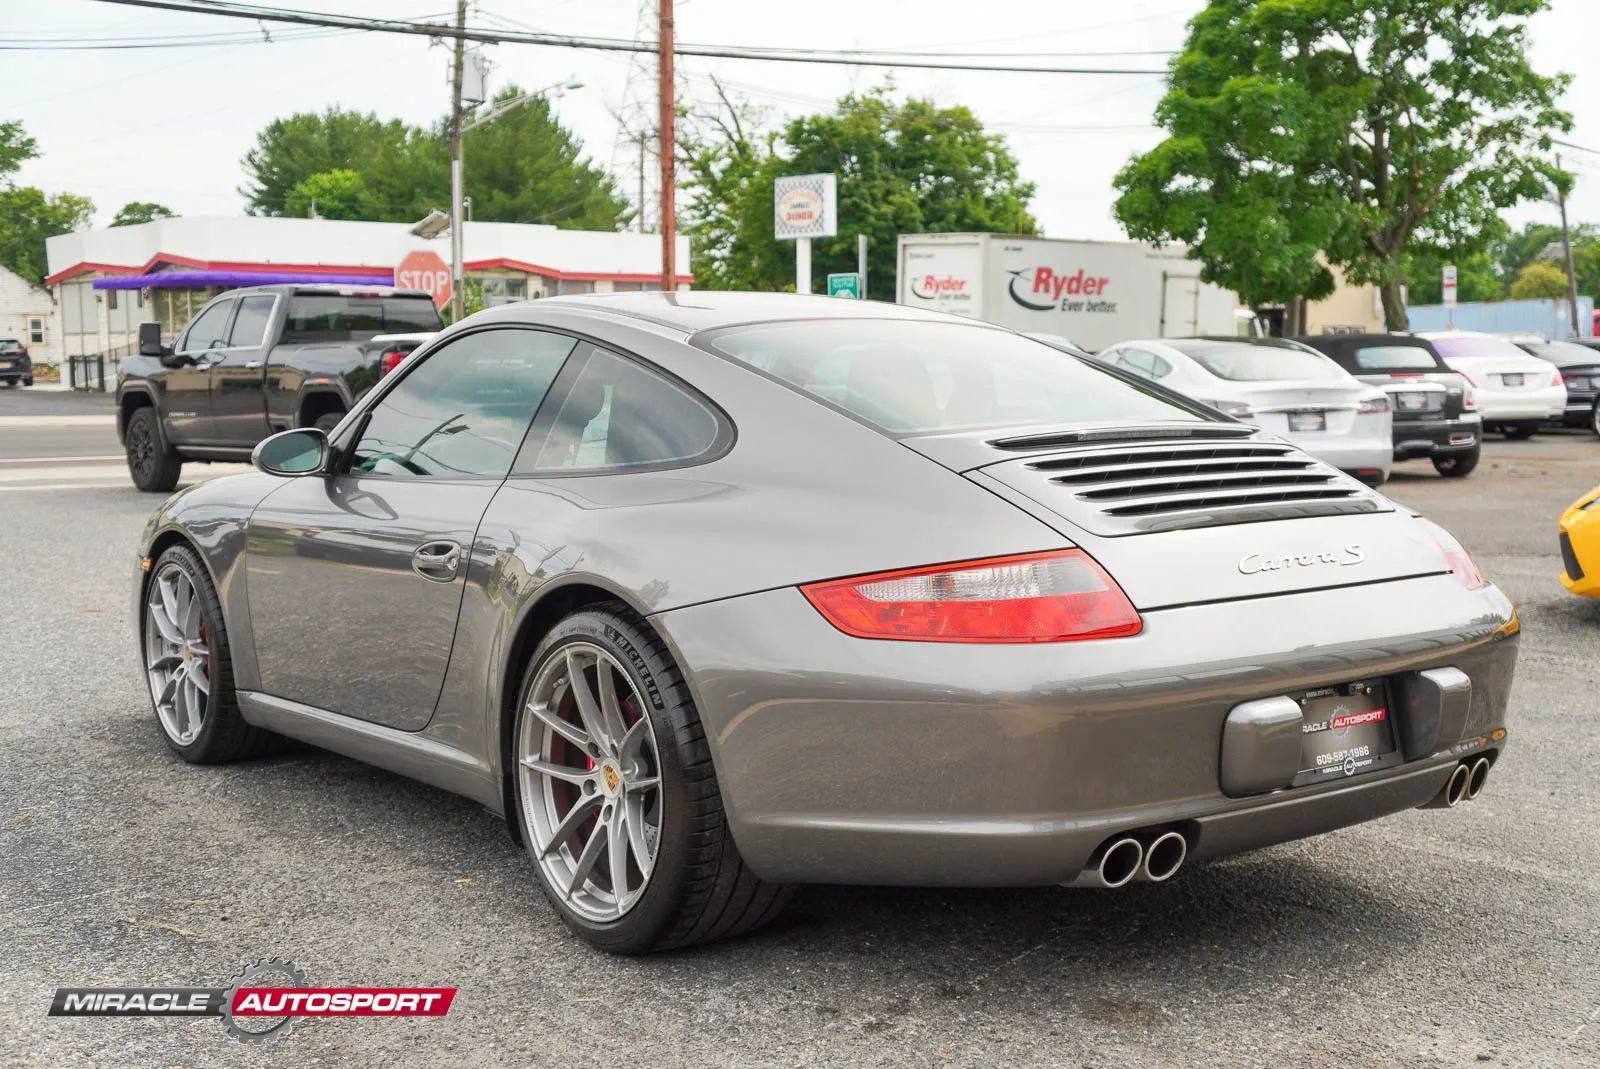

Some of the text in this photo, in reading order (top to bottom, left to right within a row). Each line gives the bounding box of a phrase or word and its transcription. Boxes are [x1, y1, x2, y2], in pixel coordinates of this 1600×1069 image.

[400, 270, 449, 295] STOP
[923, 275, 967, 294] Ryder
[1032, 266, 1110, 301] Ryder
[1061, 298, 1084, 312] Ever
[1238, 543, 1366, 575] Carrera S
[615, 635, 662, 704] MICHELIN
[1302, 711, 1383, 733] RACLE AUTOSPORT
